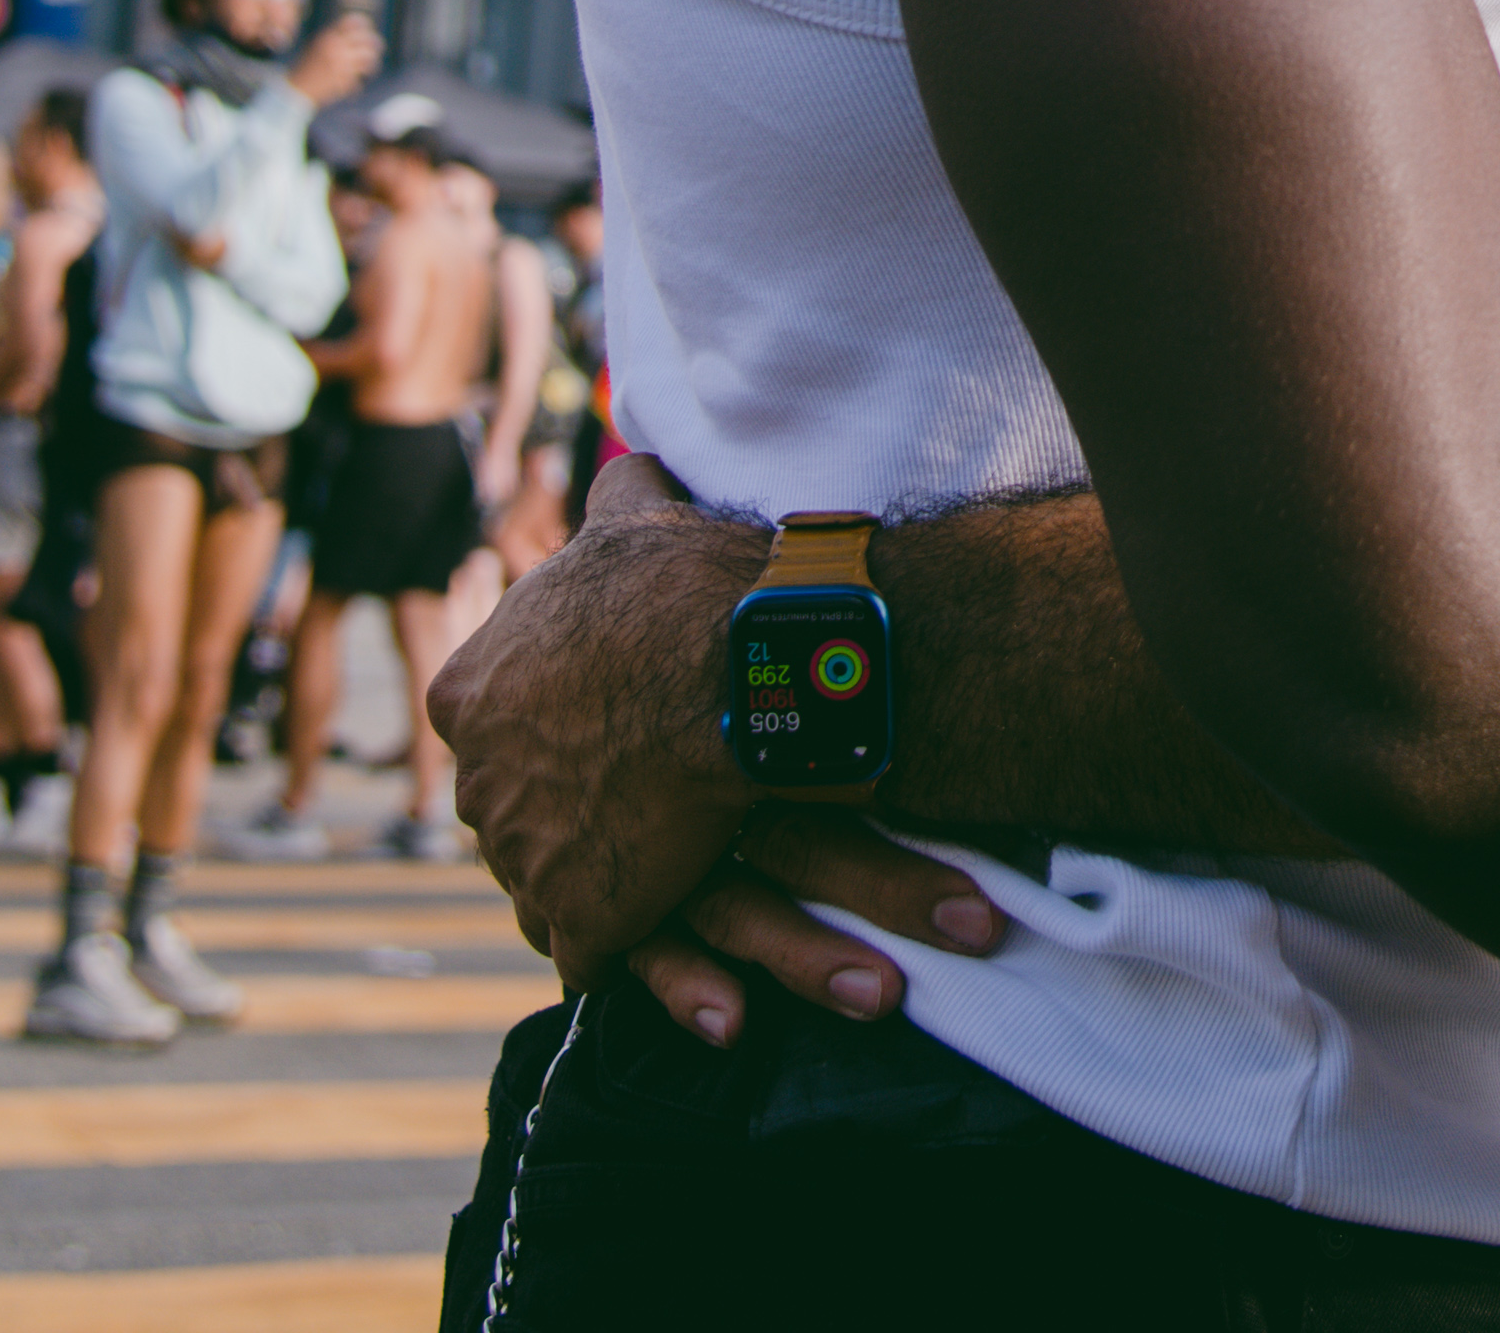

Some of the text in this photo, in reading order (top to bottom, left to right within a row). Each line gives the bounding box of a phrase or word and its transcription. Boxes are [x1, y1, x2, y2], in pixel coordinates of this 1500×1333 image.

[752, 613, 770, 622] AGO
[771, 612, 810, 622] MINUTES
[810, 611, 818, 622] 9
[843, 611, 854, 621] 81
[748, 642, 771, 662] 12
[748, 665, 791, 685] 299
[749, 688, 798, 709] 1901
[749, 711, 800, 733] 6:05
